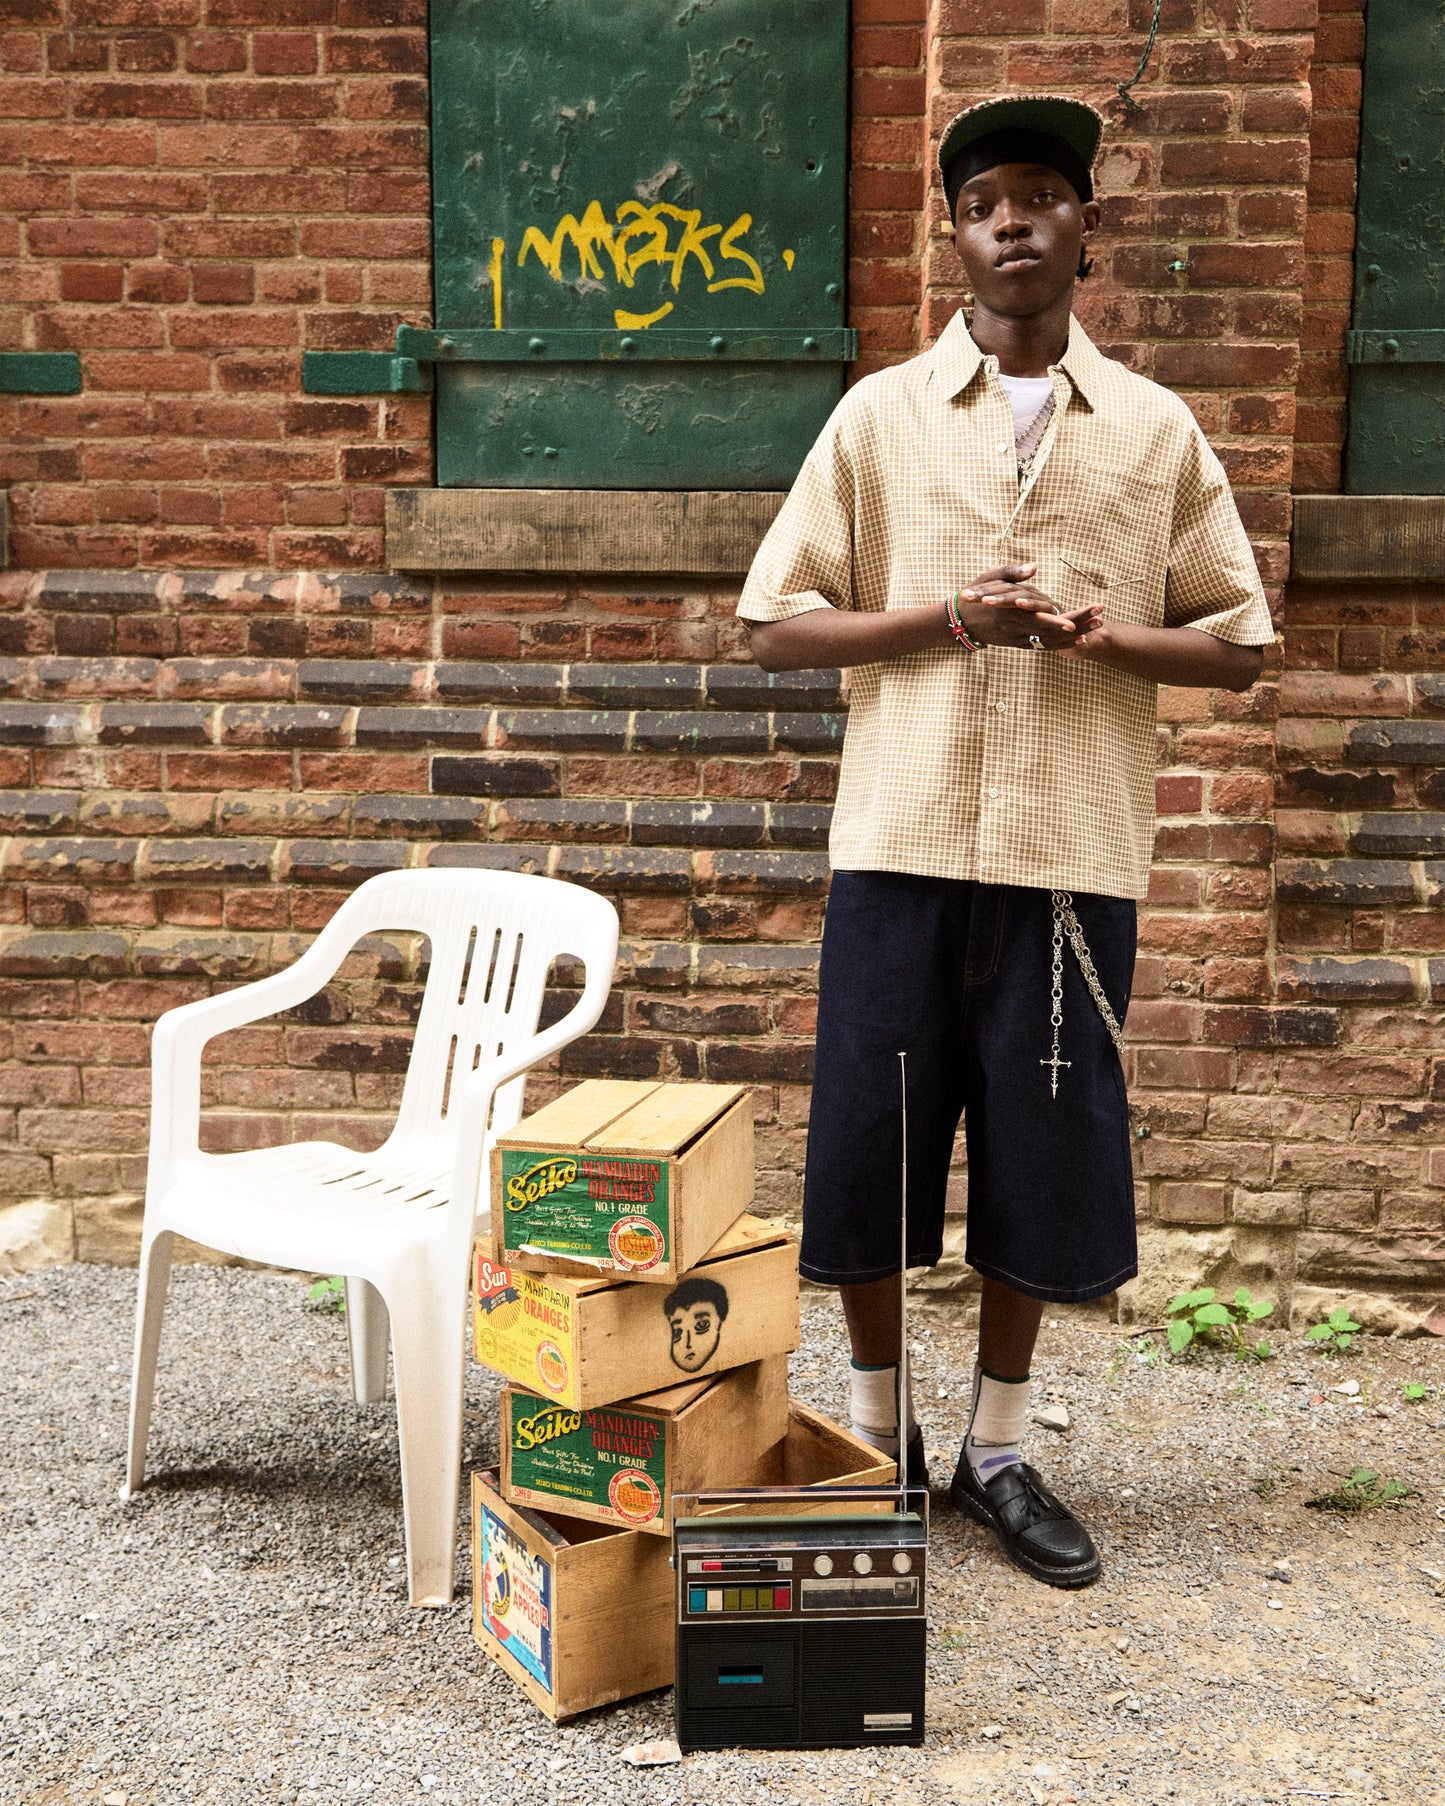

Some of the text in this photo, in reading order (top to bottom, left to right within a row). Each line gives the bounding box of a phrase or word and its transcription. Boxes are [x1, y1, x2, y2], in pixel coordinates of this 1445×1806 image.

[506, 1157, 578, 1212] Seiko
[581, 1159, 661, 1183] MANDARIN
[588, 1179, 655, 1203] ORANGES
[618, 1203, 649, 1215] GRADE
[480, 1262, 508, 1292] Sun
[524, 1279, 570, 1310] MANDARIN
[523, 1296, 570, 1334] ORANGES
[515, 1405, 582, 1450] Seiko
[586, 1410, 659, 1441] MANDARIN
[592, 1430, 655, 1459] ORANGES
[619, 1455, 648, 1471] GRADE
[513, 1487, 532, 1500] SHED
[597, 1506, 614, 1517] 1963
[513, 1589, 540, 1629] APPLES
